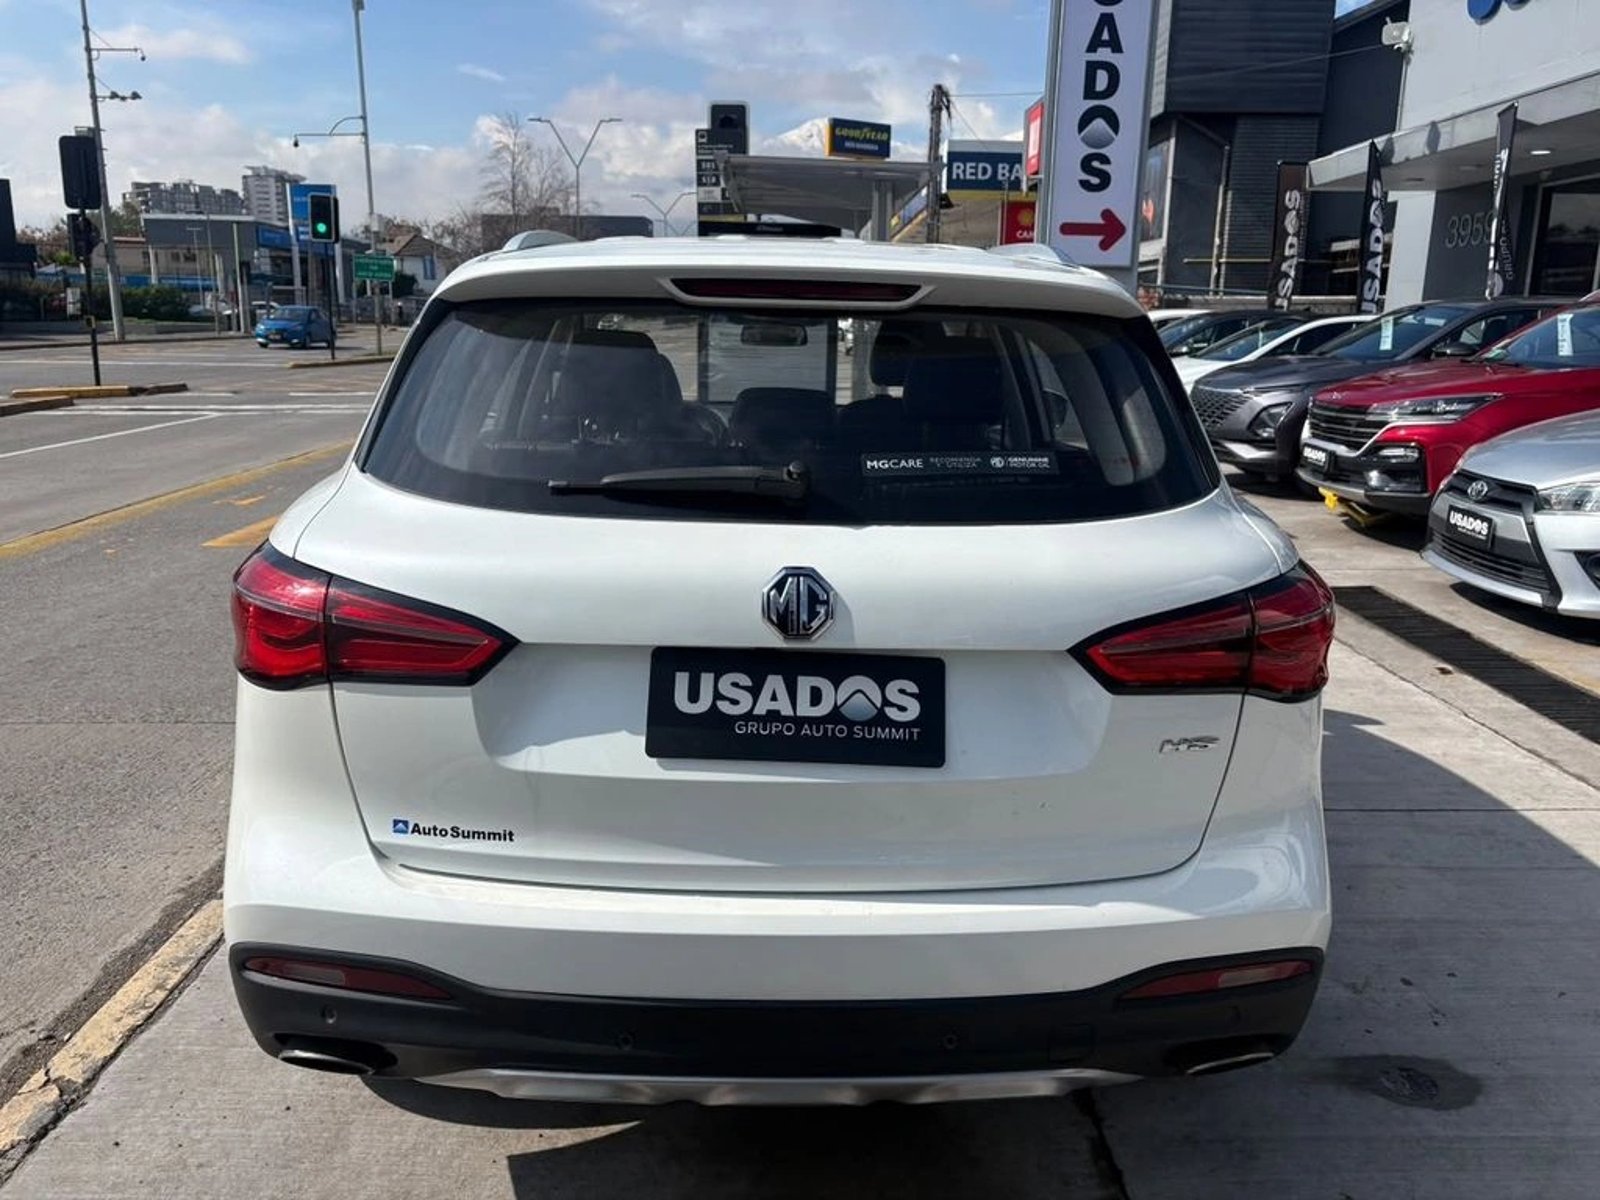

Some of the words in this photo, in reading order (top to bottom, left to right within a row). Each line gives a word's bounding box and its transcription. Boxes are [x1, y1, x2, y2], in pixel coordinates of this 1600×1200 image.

[1077, 0, 1124, 193] ADOS
[952, 162, 992, 180] RED
[1449, 510, 1489, 536] USADOS
[768, 574, 829, 637] MG
[674, 671, 922, 724] USADOS
[735, 721, 796, 737] GRUPO
[801, 724, 848, 738] AUTO
[853, 725, 921, 741] SUMMIT
